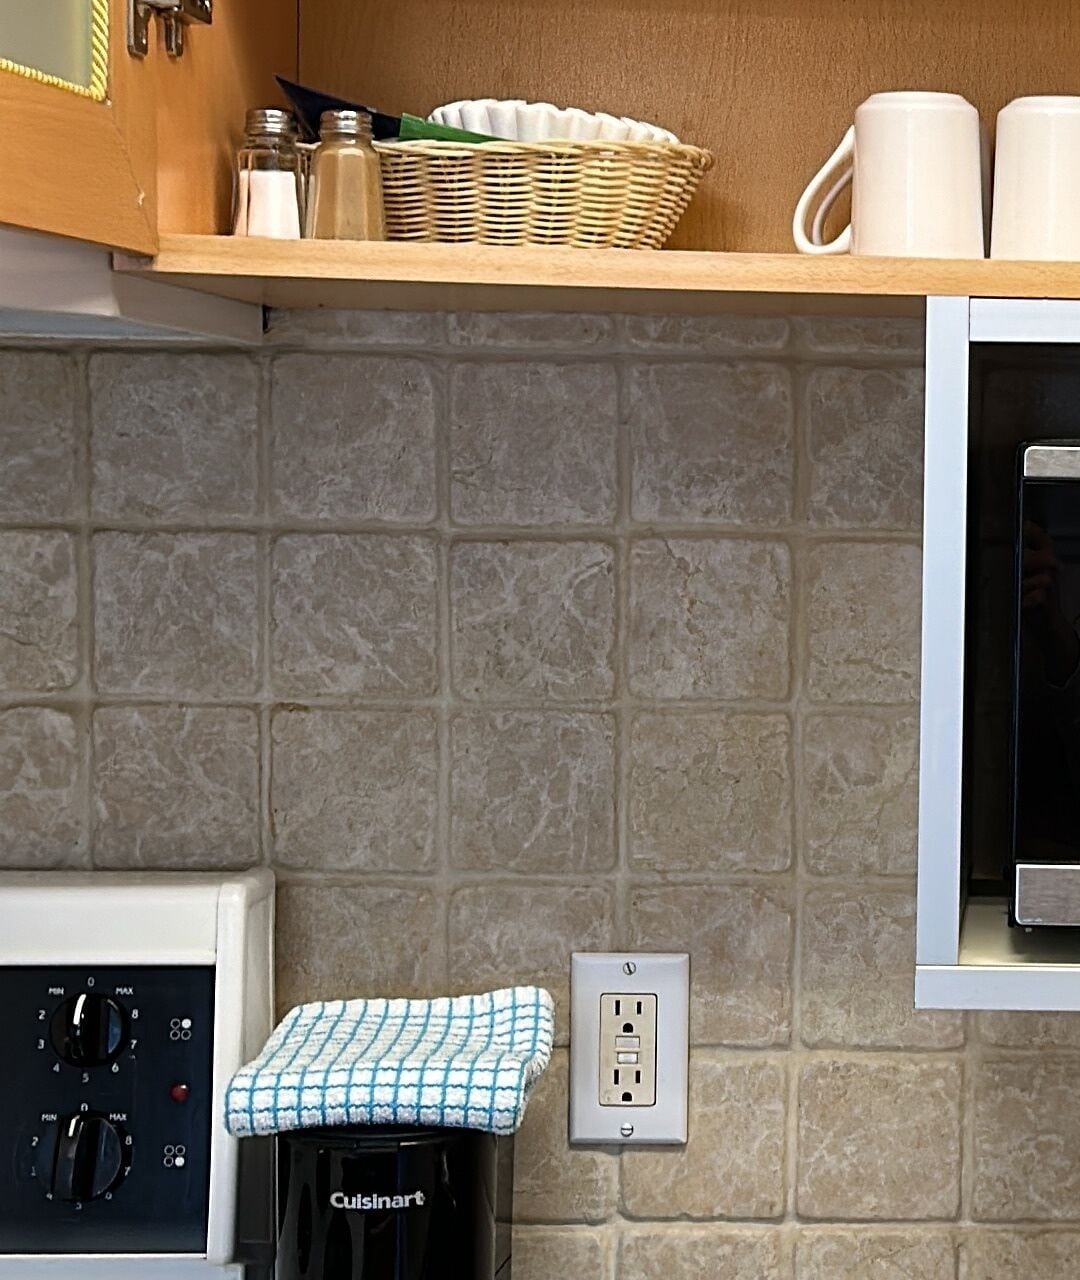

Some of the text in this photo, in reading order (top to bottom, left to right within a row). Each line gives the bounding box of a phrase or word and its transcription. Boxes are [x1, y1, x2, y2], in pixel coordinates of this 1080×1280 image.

[87, 977, 95, 988] 0
[48, 987, 65, 996] MIN
[115, 986, 134, 996] MAX
[38, 1009, 46, 1021] 2
[131, 1009, 139, 1019] 8
[37, 1039, 45, 1050] 3
[130, 1039, 138, 1050] 7
[52, 1063, 60, 1073] 4
[111, 1063, 119, 1073] 6
[81, 1073, 89, 1083] 5
[41, 1113, 58, 1121] MIN
[109, 1112, 127, 1121] MAX
[31, 1136, 39, 1147] 2
[125, 1135, 133, 1146] 8
[124, 1166, 131, 1177] 7
[329, 1190, 425, 1210] Cuisinart
